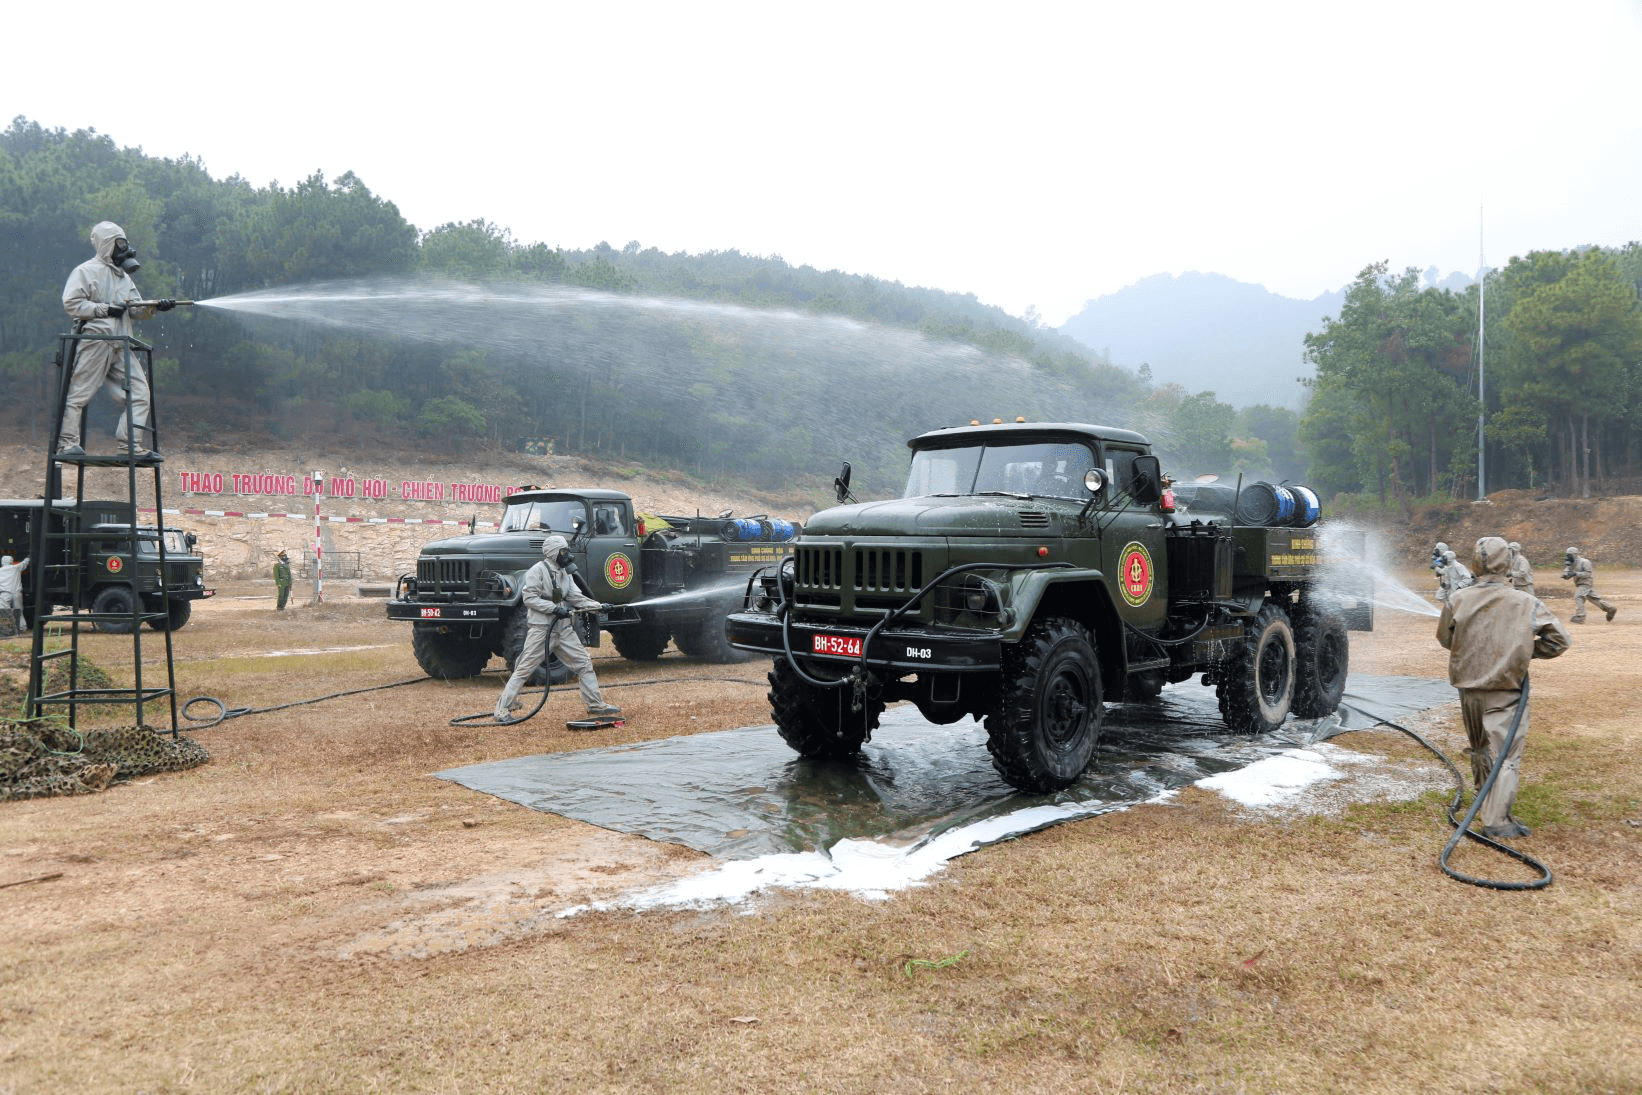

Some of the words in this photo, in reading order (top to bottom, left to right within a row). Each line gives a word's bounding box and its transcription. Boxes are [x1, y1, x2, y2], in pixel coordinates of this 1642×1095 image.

[180, 472, 224, 493] THAO
[814, 635, 860, 655] BH-52-64
[906, 646, 932, 659] DH-03
